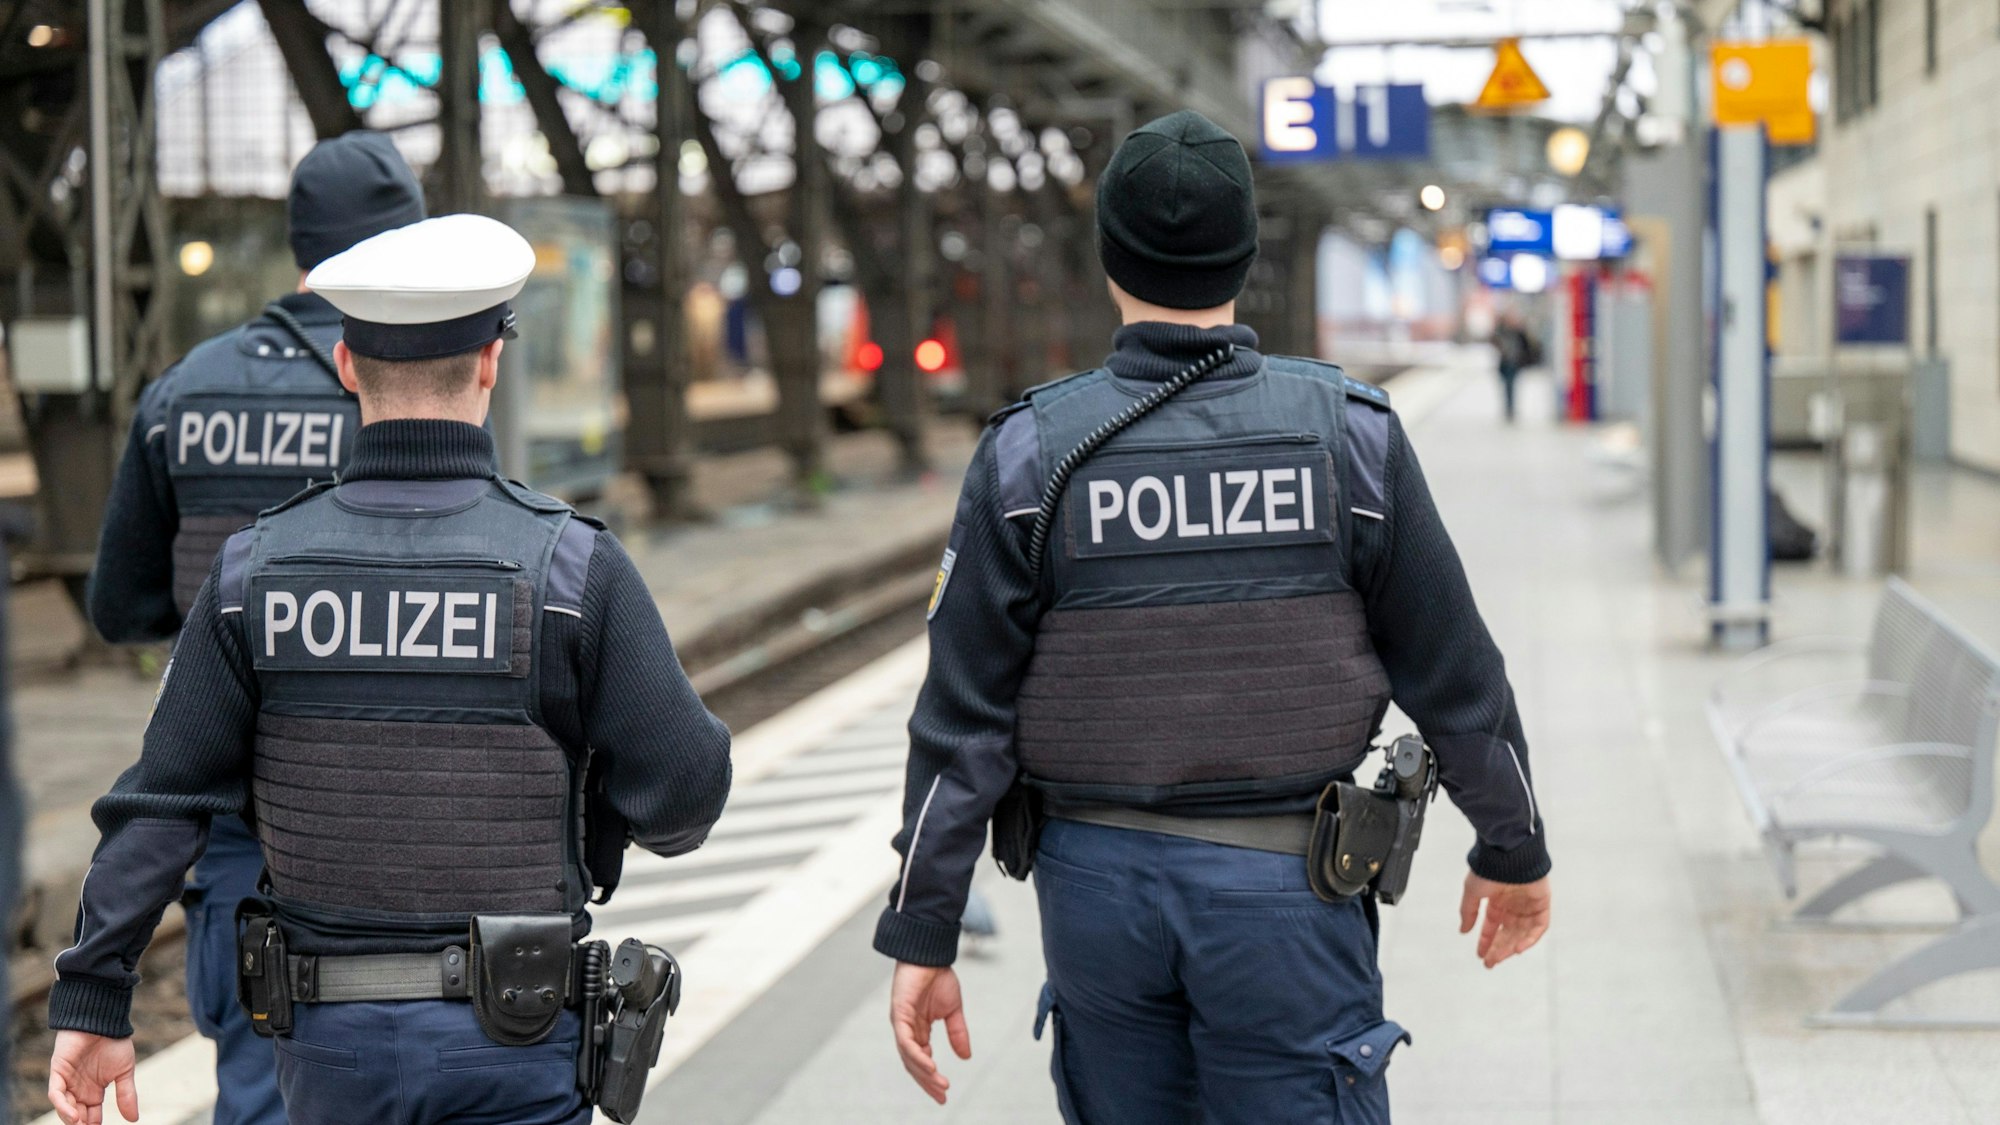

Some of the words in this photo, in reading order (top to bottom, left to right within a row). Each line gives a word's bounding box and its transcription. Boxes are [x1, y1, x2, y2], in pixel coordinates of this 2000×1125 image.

[1263, 75, 1318, 152] E
[177, 410, 344, 467] POLIZEI
[1088, 466, 1316, 544] POLIZEI
[264, 589, 499, 659] POLIZEI
